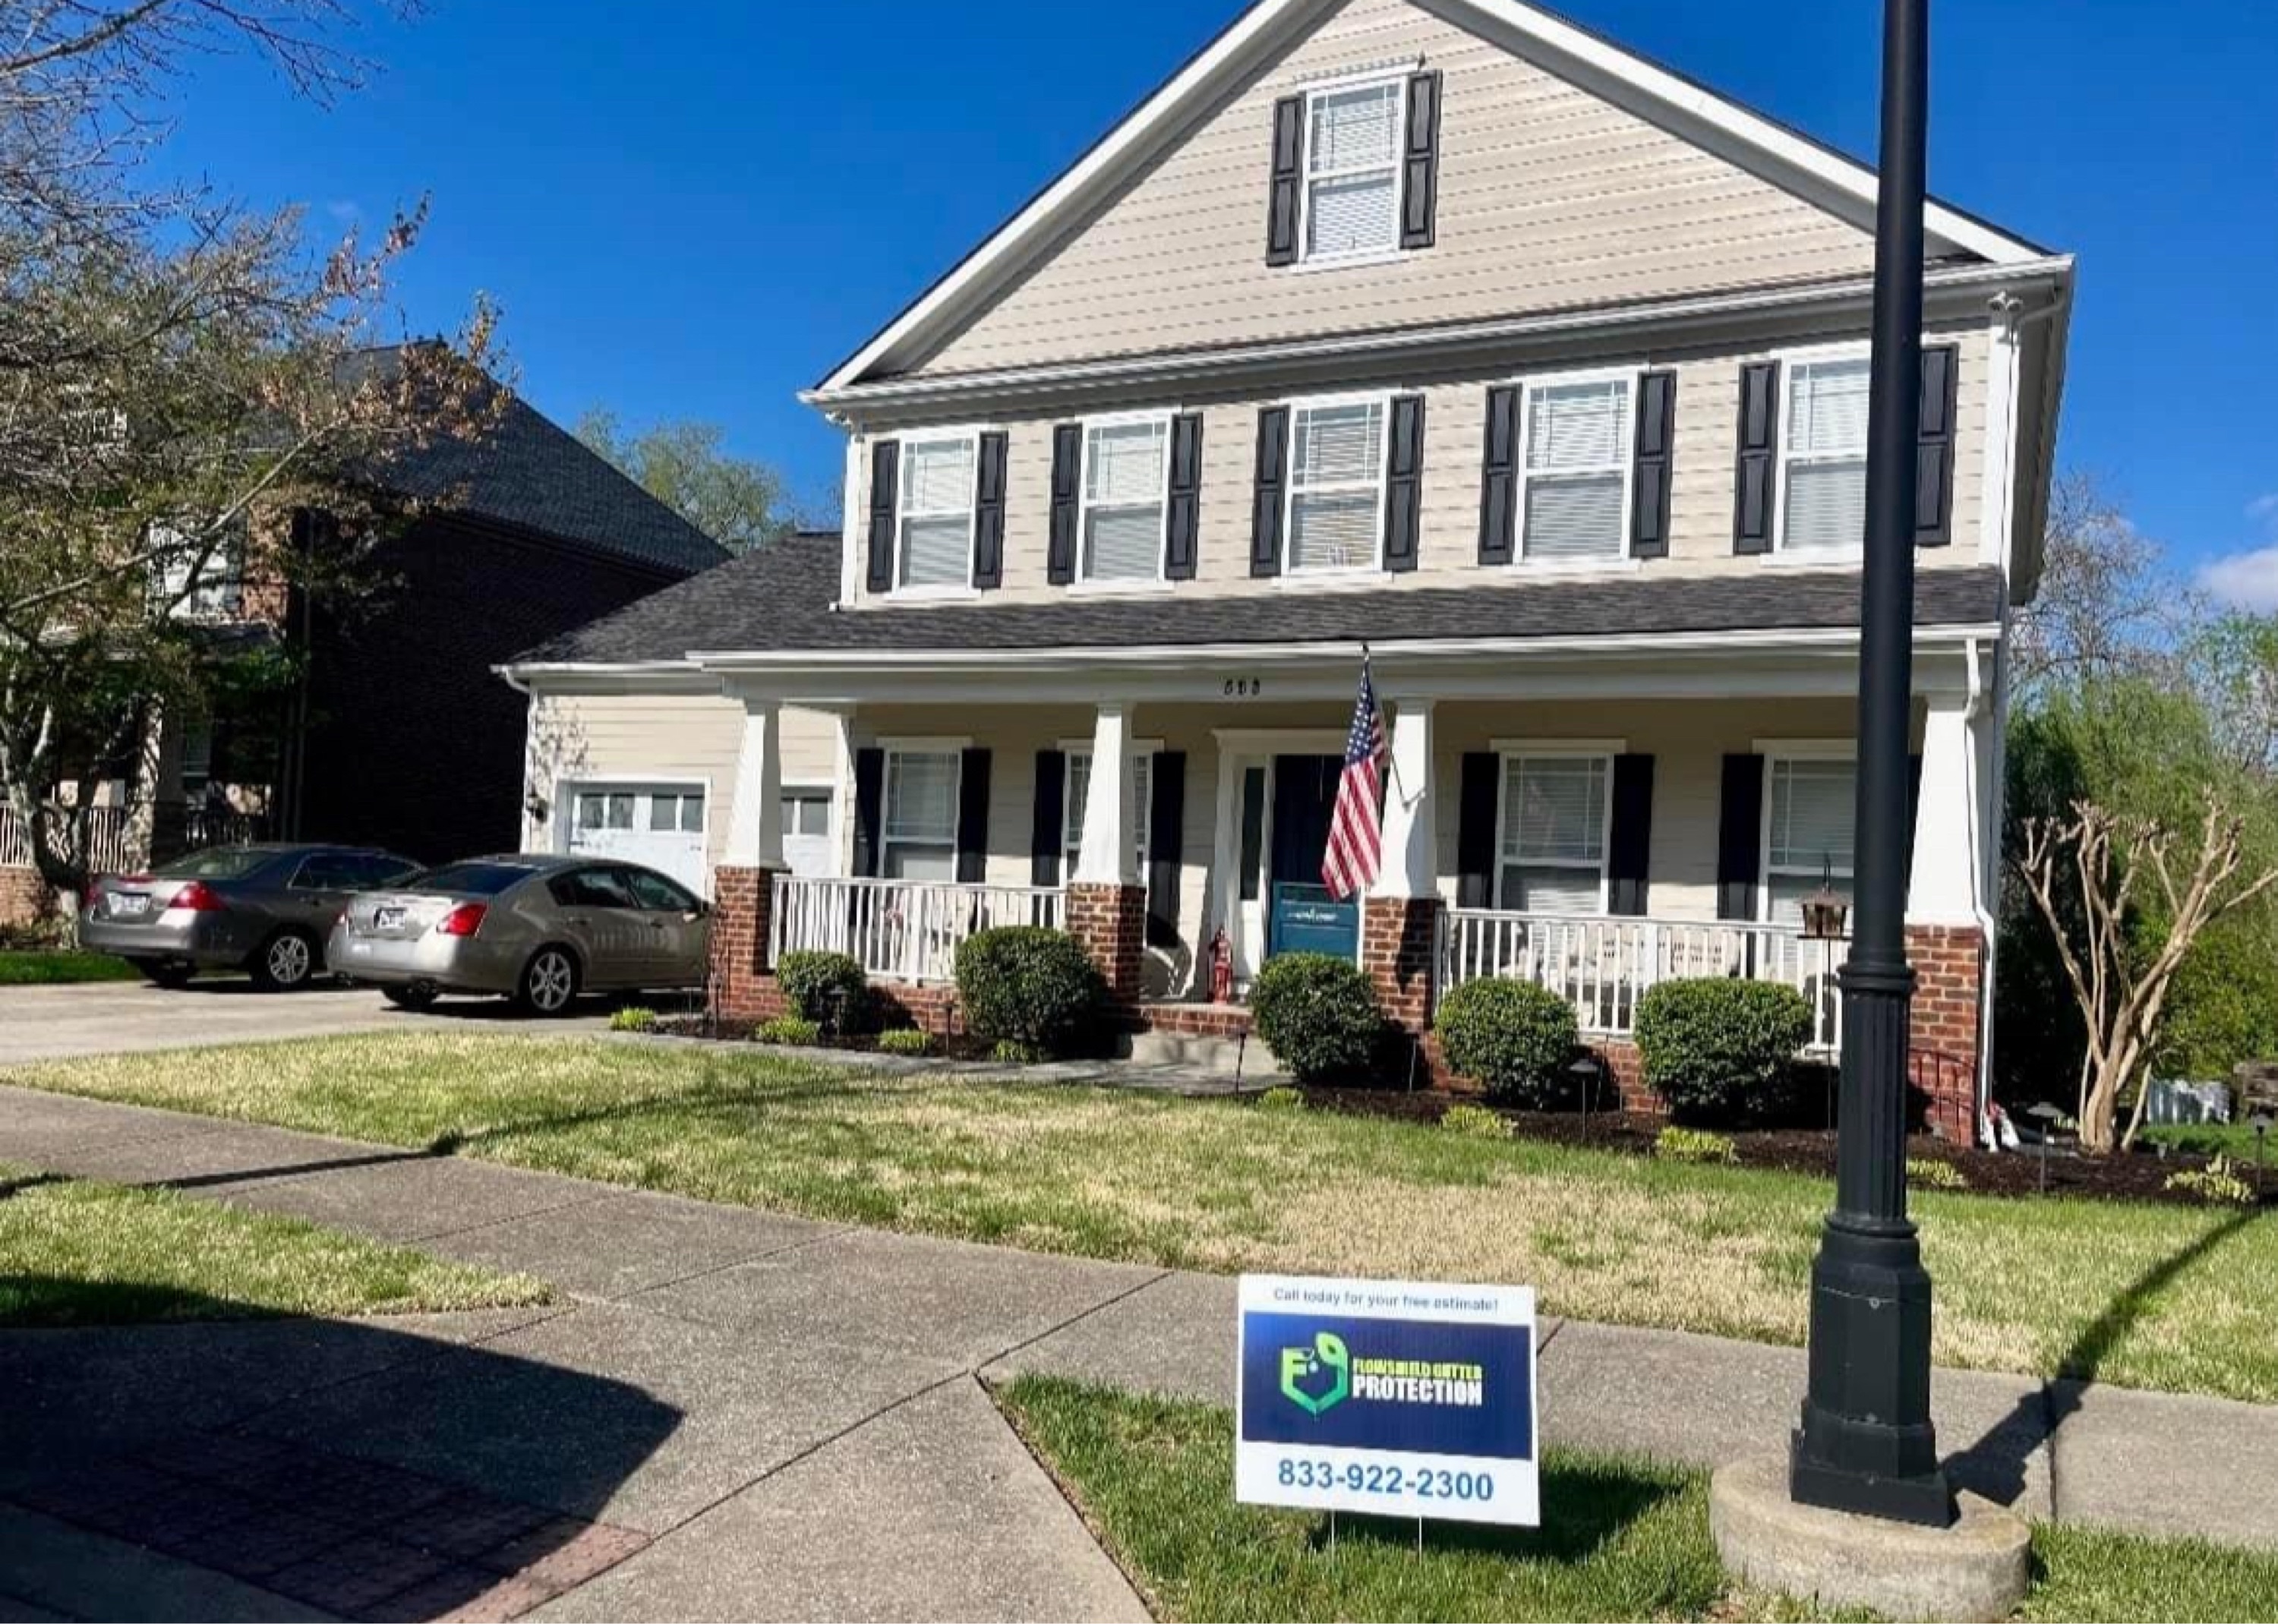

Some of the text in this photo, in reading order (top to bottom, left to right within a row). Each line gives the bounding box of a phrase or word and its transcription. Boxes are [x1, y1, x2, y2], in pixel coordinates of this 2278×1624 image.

[1273, 1287, 1499, 1311] Call today for your free estimate!
[1352, 1375, 1483, 1406] PROTECTION
[1278, 1458, 1494, 1501] 833-922-2300
